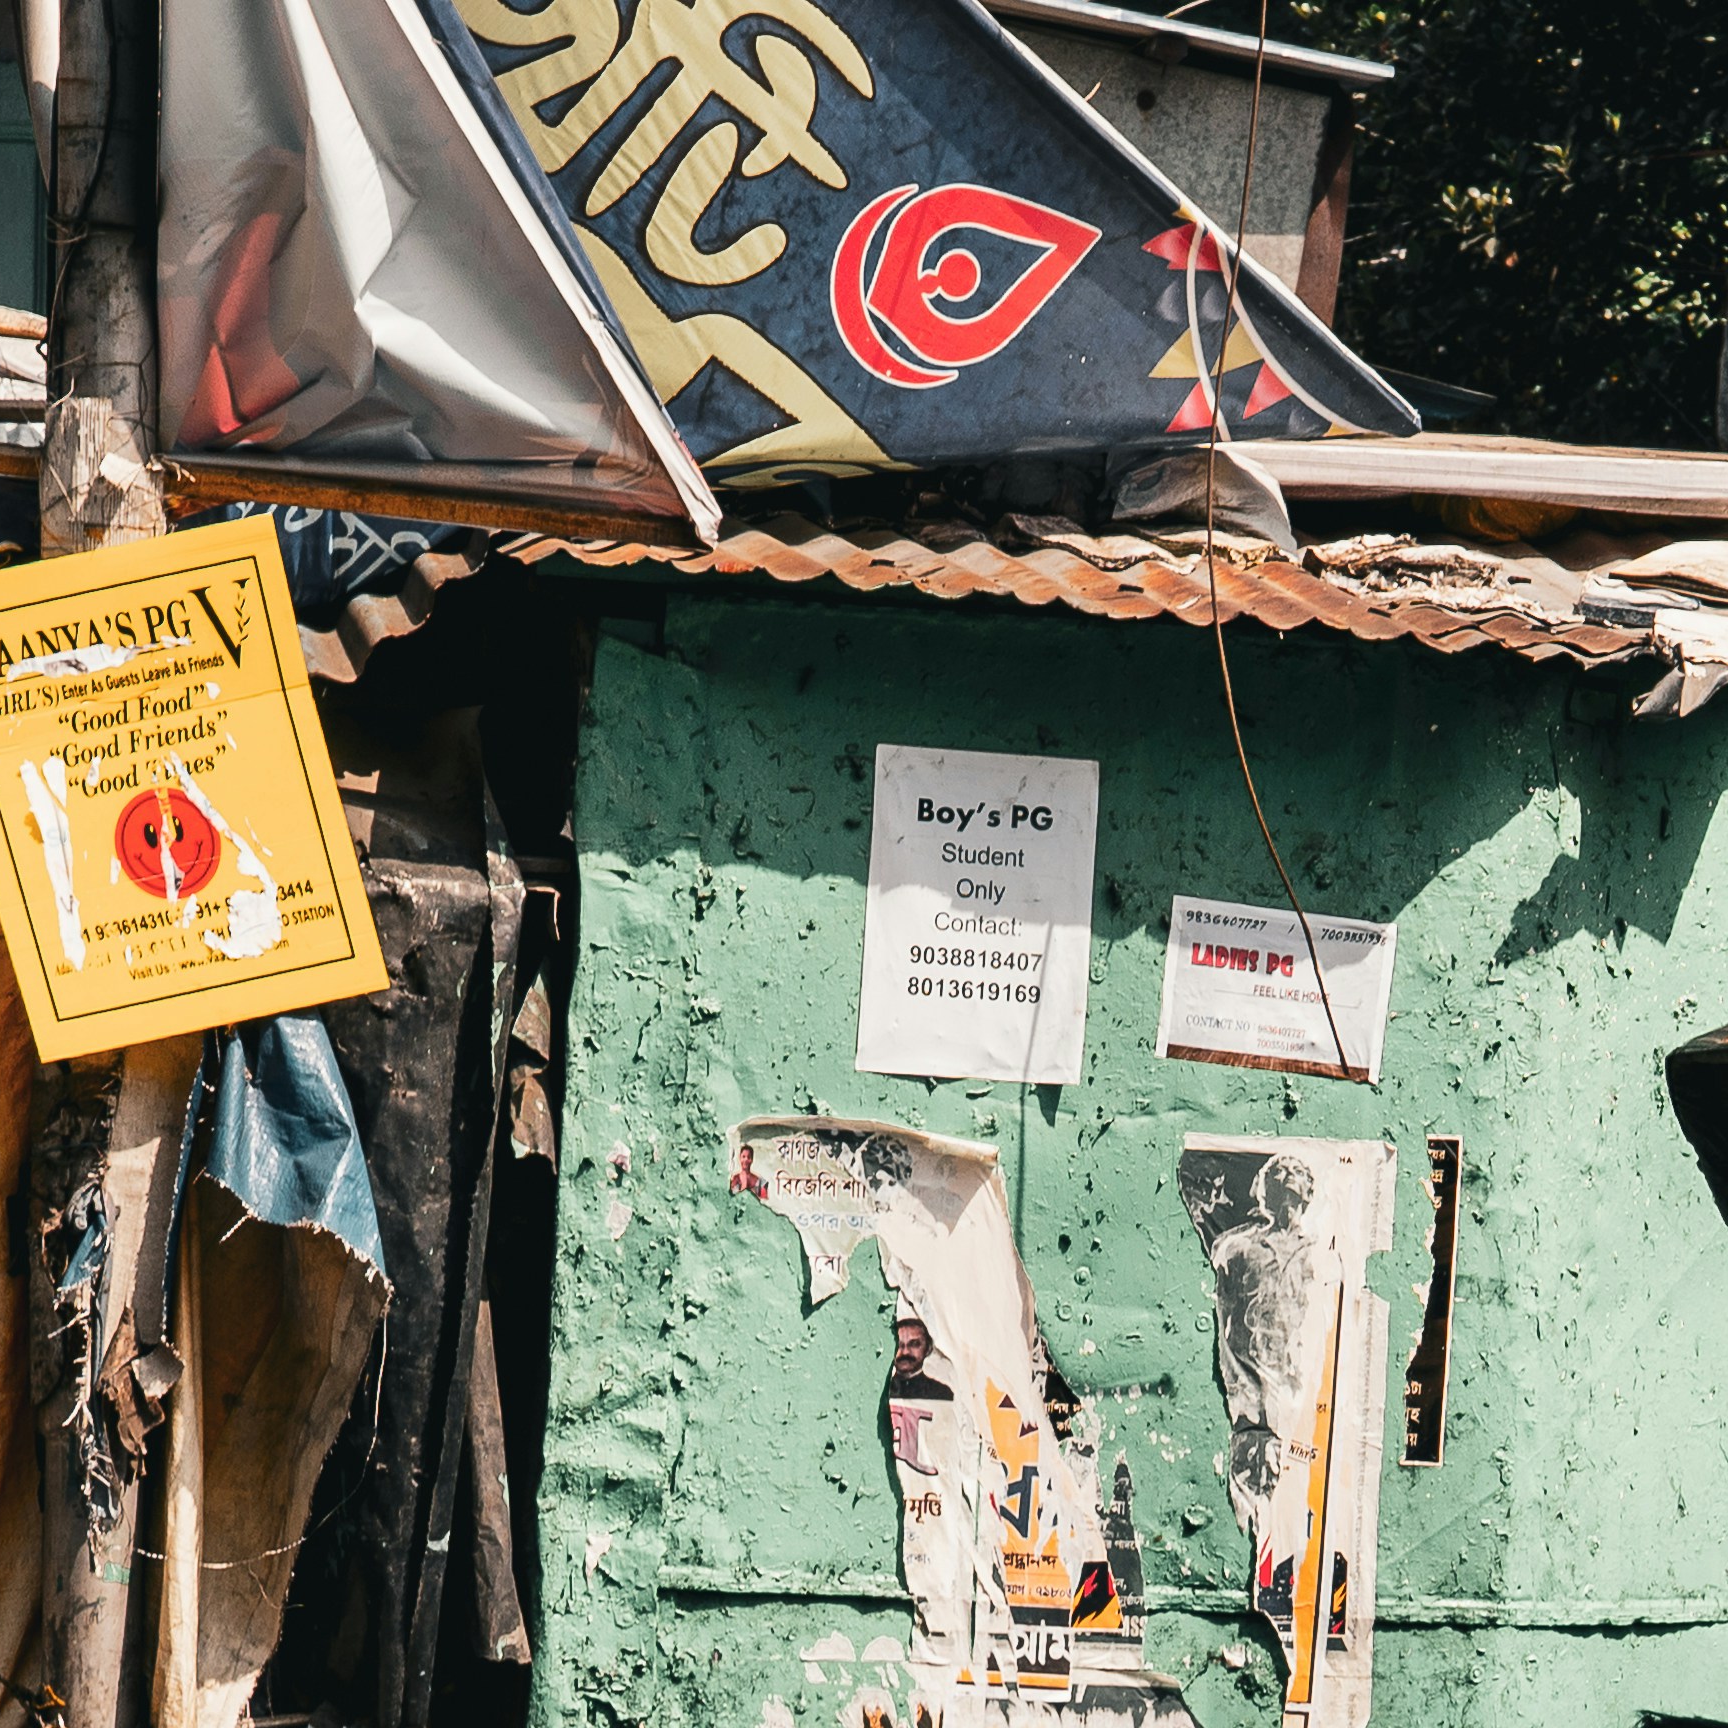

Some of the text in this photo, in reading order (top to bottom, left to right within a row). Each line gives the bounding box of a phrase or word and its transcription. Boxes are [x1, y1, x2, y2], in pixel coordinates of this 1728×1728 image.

[145, 599, 194, 643] PG
[61, 682, 90, 700] Enter
[91, 680, 105, 696] As
[105, 670, 141, 693] Guests
[141, 665, 172, 684] Leave
[173, 661, 187, 677] As
[187, 653, 226, 674] Friends
[916, 797, 1054, 832] Boy's PG
[940, 841, 1025, 869] Student
[955, 877, 1006, 906] Only
[291, 903, 337, 926] STATION
[933, 911, 1023, 937] Contact:
[908, 944, 1043, 973] 9038818407
[1190, 941, 1294, 978] LADIES PG
[128, 966, 153, 982] Visit
[154, 964, 171, 978] Us
[906, 976, 1042, 1004] 8013619169
[1252, 983, 1278, 998] FEEL
[1278, 986, 1301, 1000] LIKE
[1185, 1014, 1234, 1031] CONTACT
[1234, 1019, 1251, 1031] NO
